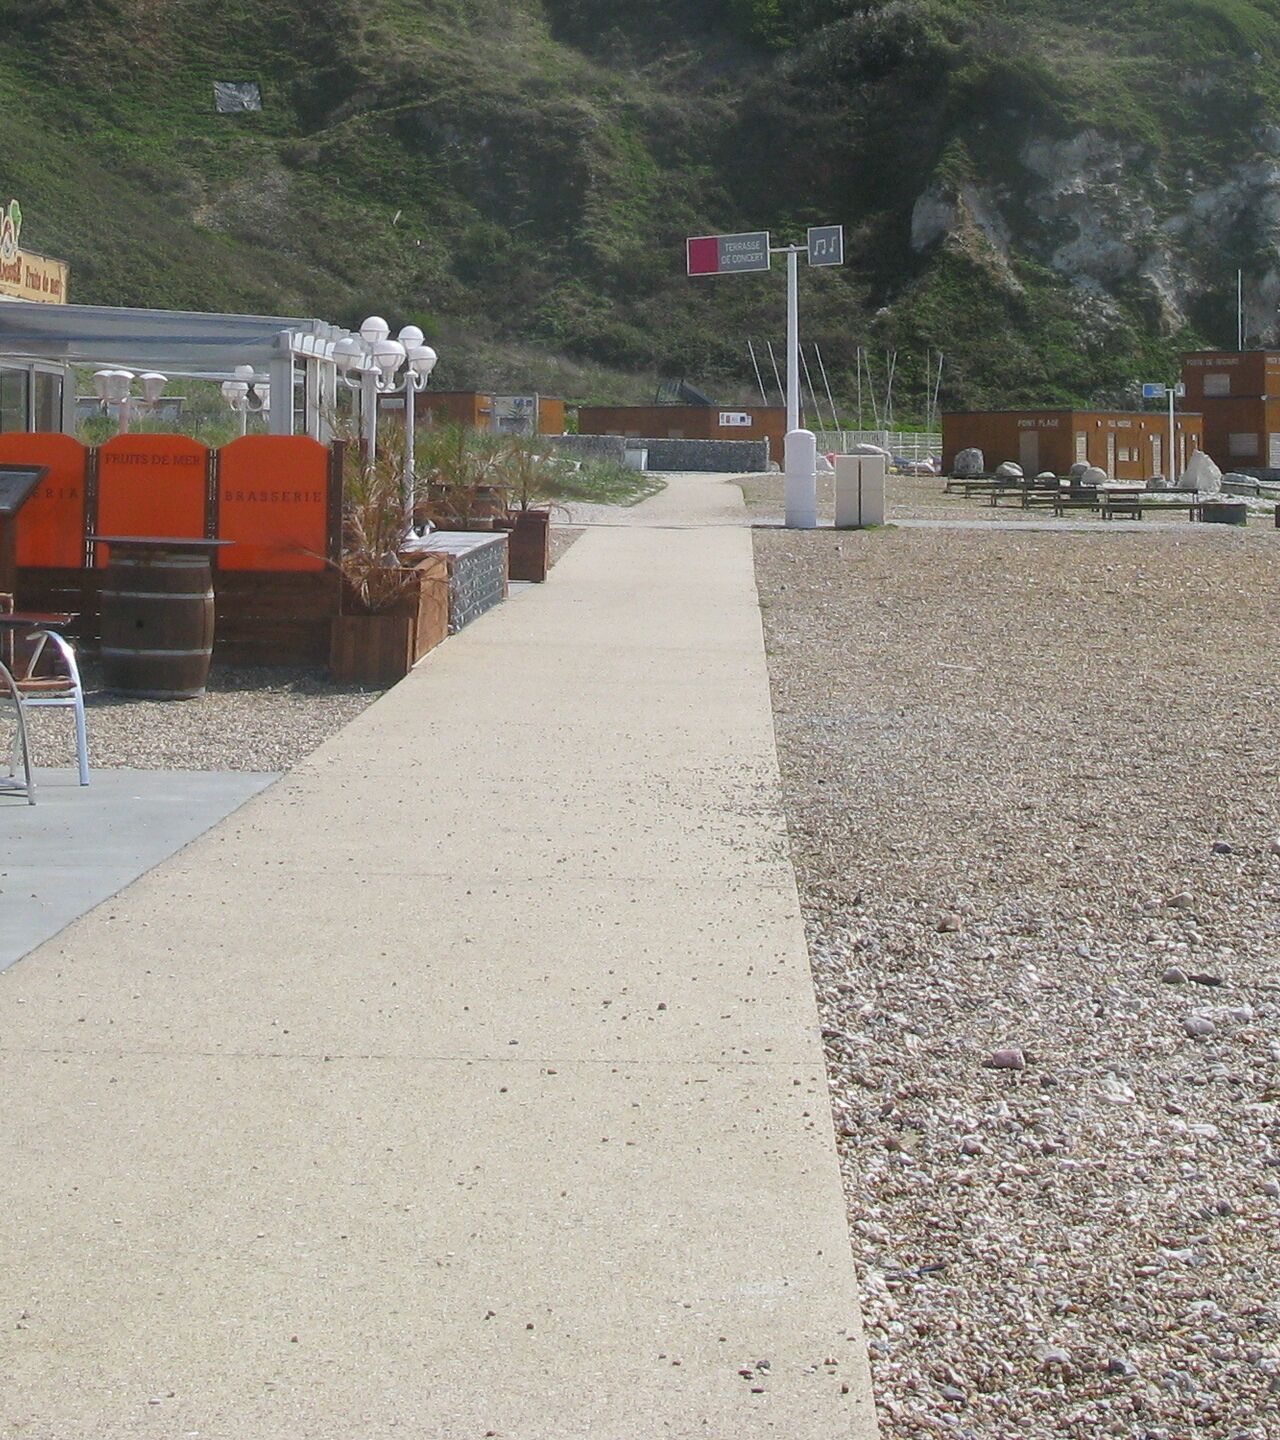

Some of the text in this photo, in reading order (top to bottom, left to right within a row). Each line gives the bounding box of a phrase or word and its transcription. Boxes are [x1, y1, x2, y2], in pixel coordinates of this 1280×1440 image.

[725, 241, 761, 252] TERRASSE
[721, 252, 763, 265] DE CONCERT
[105, 454, 201, 466] FRUITS DE MER
[224, 491, 322, 503] BRASSERIE
